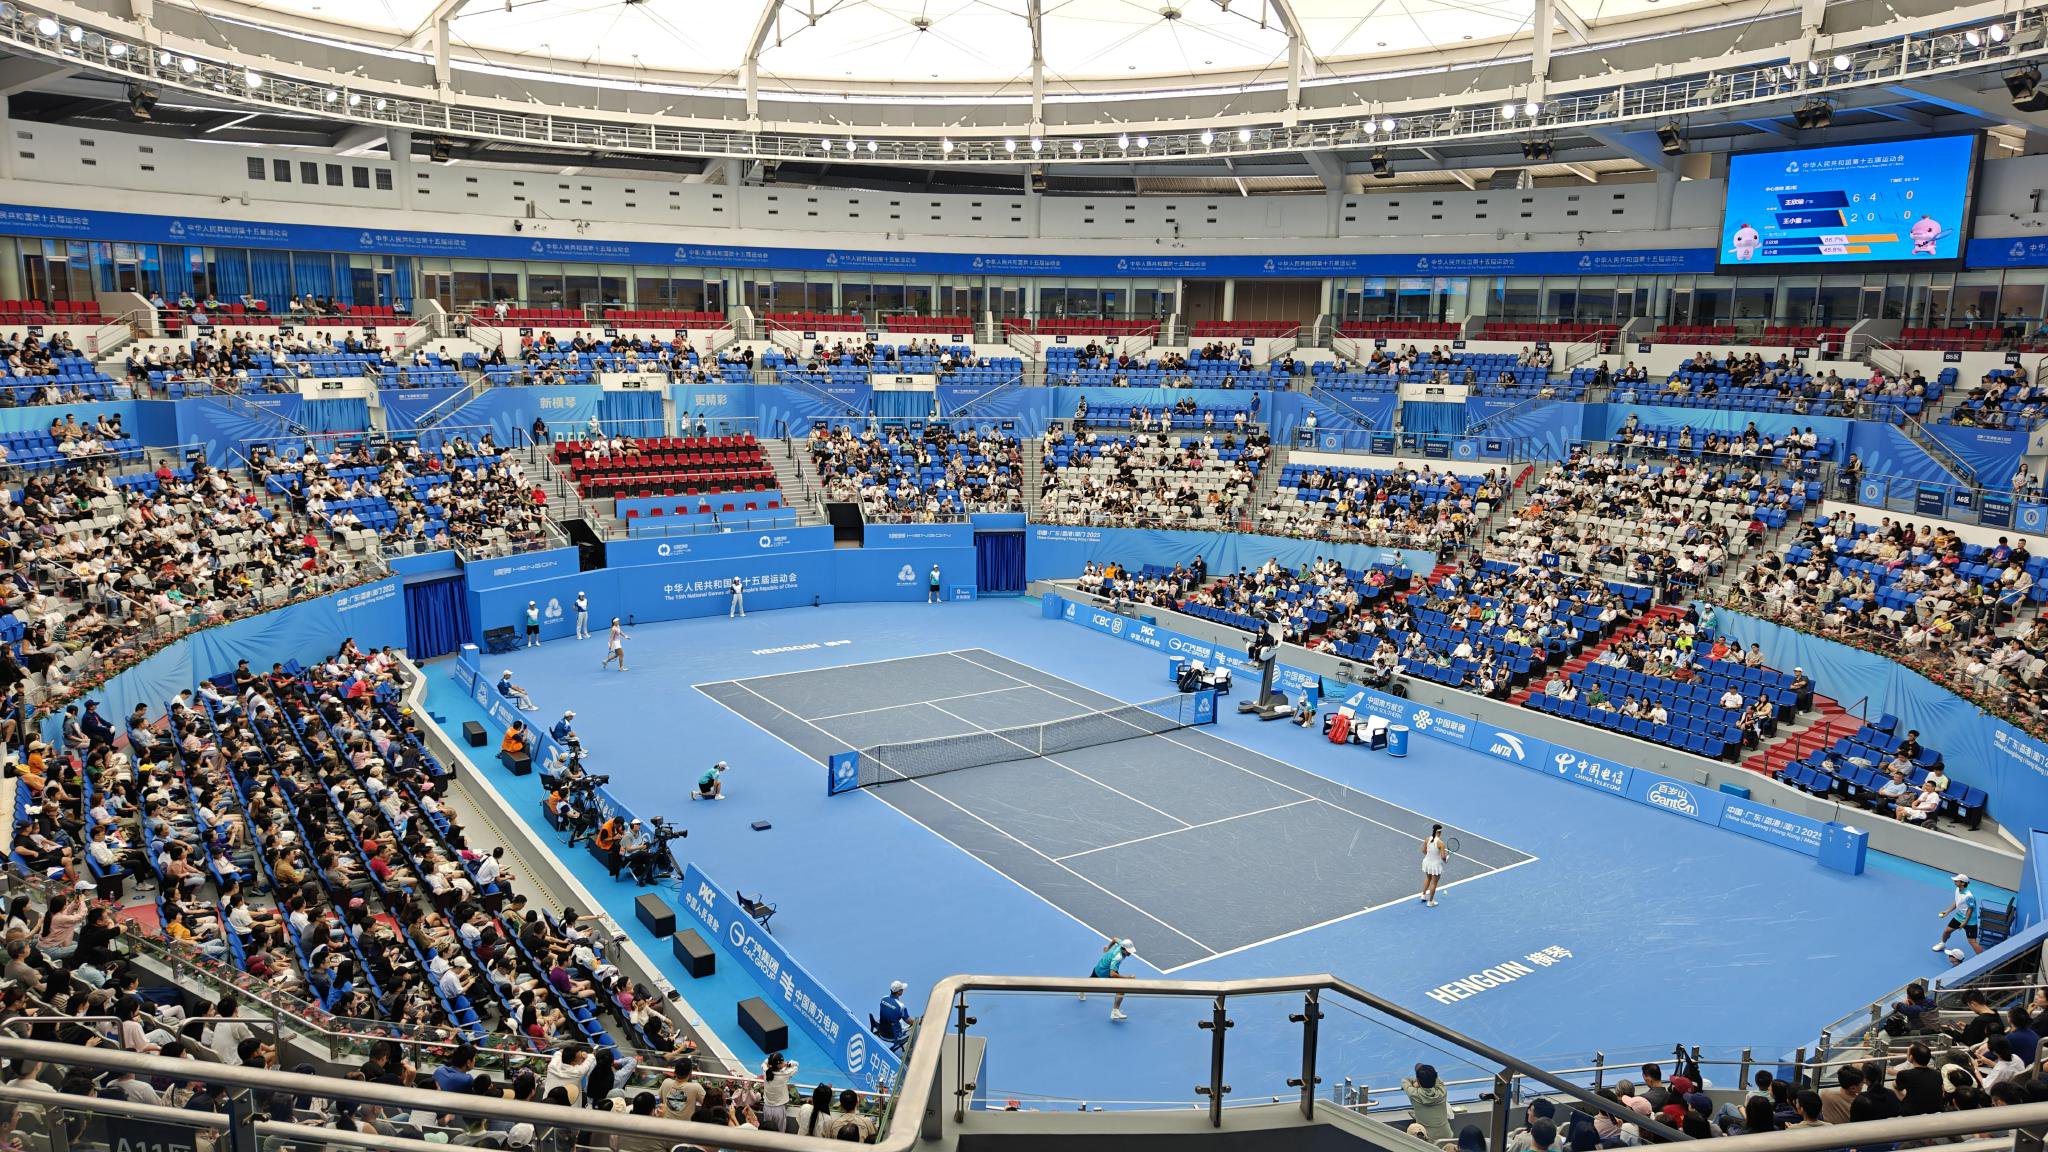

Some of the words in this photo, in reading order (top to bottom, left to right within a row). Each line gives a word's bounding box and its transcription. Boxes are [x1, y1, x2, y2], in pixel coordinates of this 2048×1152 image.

[1852, 194, 1860, 202] 6
[1869, 193, 1877, 201] 4
[1905, 190, 1913, 199] 0
[1850, 214, 1858, 222] 2
[1903, 211, 1911, 219] 0
[539, 396, 577, 410] 新横琴
[695, 393, 727, 407] 更精彩
[2036, 436, 2044, 448] 4
[1546, 556, 1555, 564] W
[664, 573, 798, 594] 中华人民共和国十五届运动会
[687, 591, 707, 599] National
[759, 584, 779, 592] Republic
[1093, 614, 1111, 628] ICBC
[1141, 625, 1156, 637] PICC
[1282, 679, 1296, 689] China
[1284, 670, 1313, 685] 中国移动
[1365, 704, 1379, 713] CHINA
[1379, 707, 1402, 720] SOUTHERN
[1367, 695, 1404, 714] 中国南方航空
[1435, 717, 1466, 733] 中国联通
[1489, 743, 1513, 758] ANTA
[1577, 759, 1624, 785] 中国电信
[1574, 773, 1593, 783] CHINA
[1593, 778, 1621, 792] TELECOM
[1658, 784, 1687, 799] 百岁山
[1771, 825, 1786, 837] Hong
[1786, 830, 1801, 842] Kong
[698, 881, 716, 909] PICC
[744, 936, 780, 975] 广汽集团
[742, 946, 756, 963] GAC
[754, 957, 776, 982] GROUP
[1424, 960, 1535, 1005] HENGQIN
[1523, 945, 1573, 968] 横琴
[795, 989, 839, 1039] 中国南方电网
